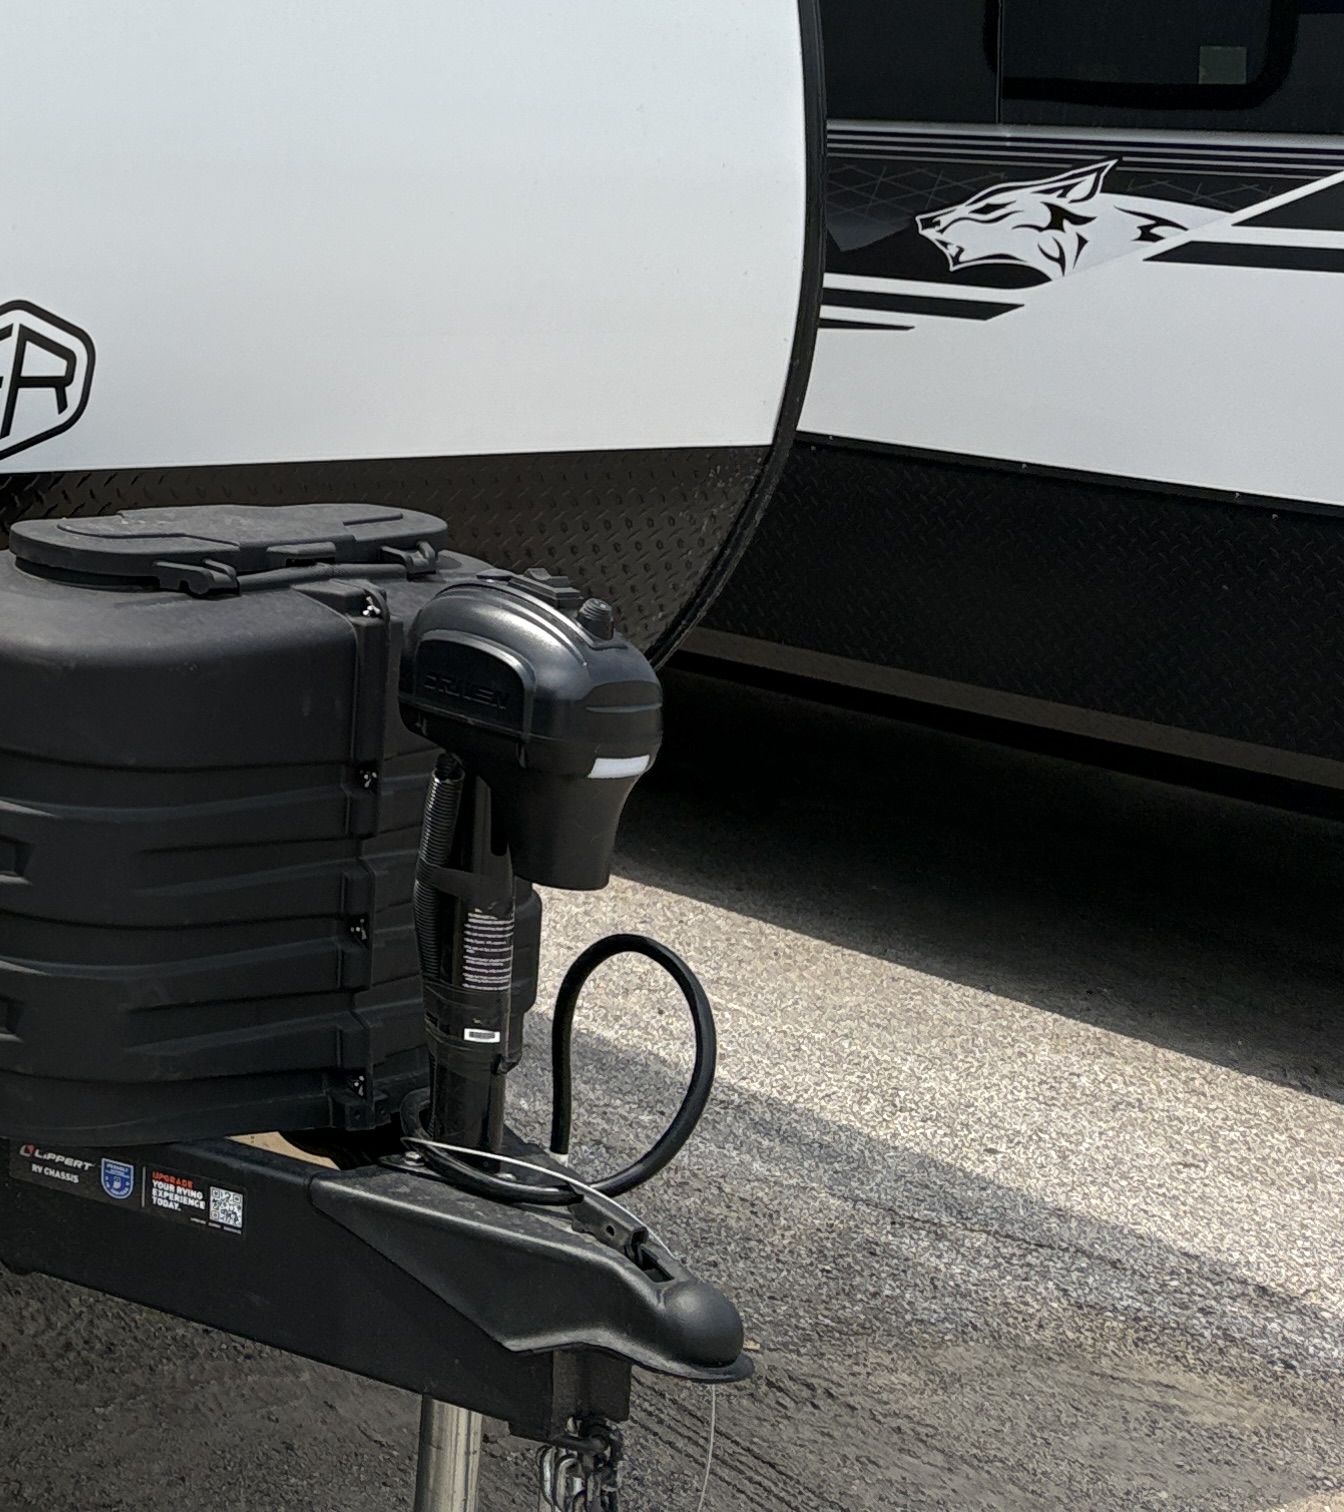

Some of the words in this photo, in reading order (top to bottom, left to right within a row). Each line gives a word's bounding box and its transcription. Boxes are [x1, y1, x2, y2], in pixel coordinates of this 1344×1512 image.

[34, 1149, 94, 1171] LIPPERT
[32, 1163, 43, 1174] RV
[44, 1167, 79, 1184] CHASSIS
[152, 1170, 194, 1188] UPGRADE
[152, 1179, 175, 1193] YOUR
[177, 1186, 203, 1200] RVING
[152, 1188, 205, 1210] EXPERIENCE
[152, 1196, 182, 1212] TODAY.
